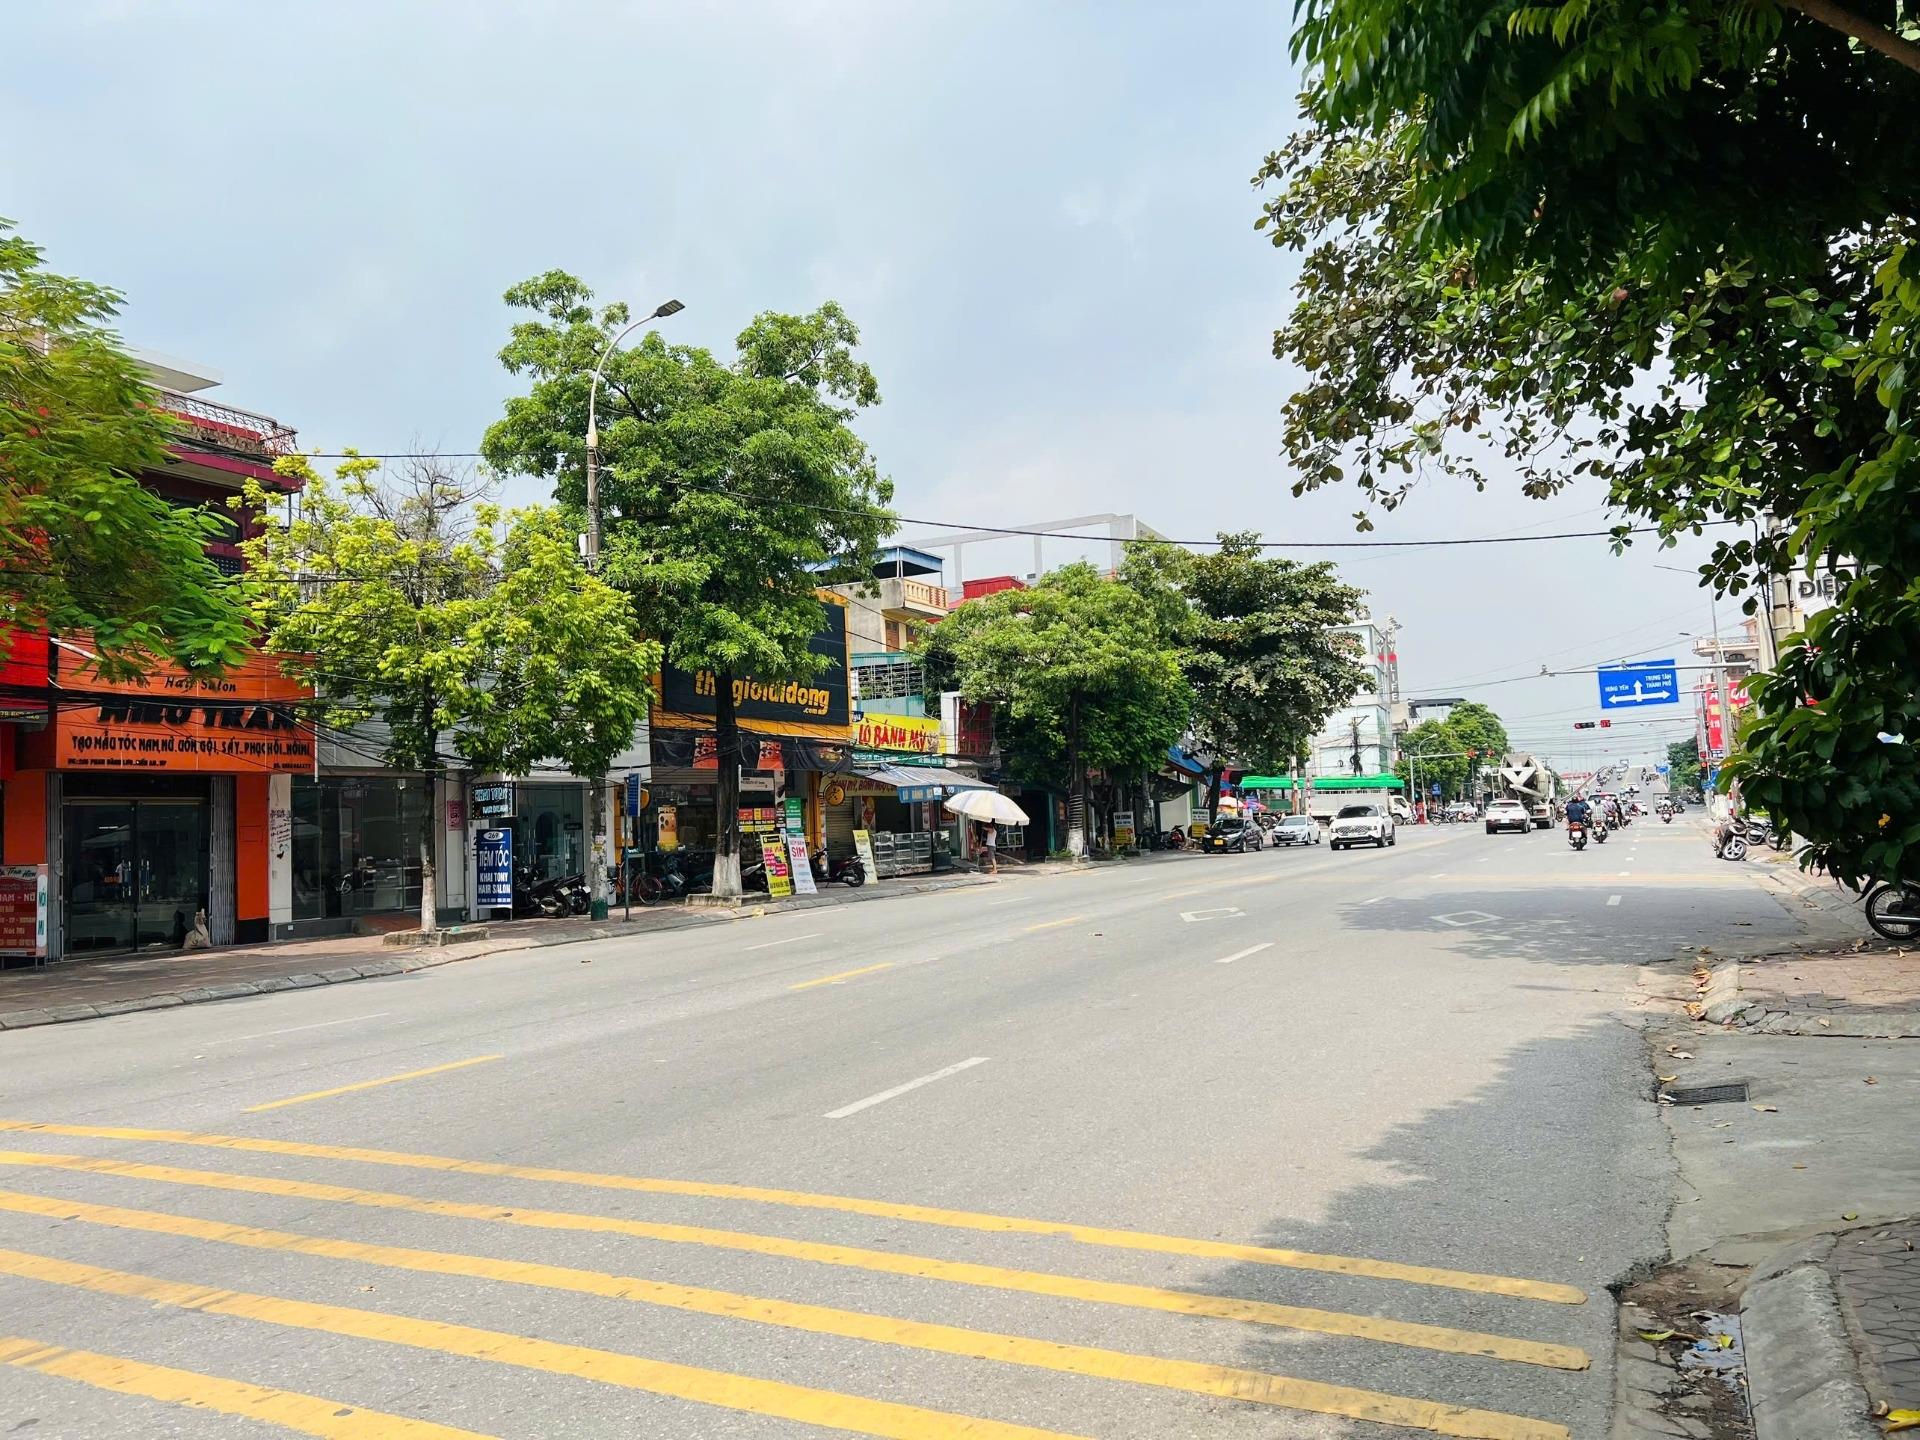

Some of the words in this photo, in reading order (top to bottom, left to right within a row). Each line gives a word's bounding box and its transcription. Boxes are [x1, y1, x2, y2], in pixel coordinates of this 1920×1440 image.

[201, 679, 236, 693] Salon
[695, 669, 830, 715] thgioididong
[72, 735, 92, 753] TẠO
[94, 728, 116, 751] MẪU
[118, 733, 137, 751] TÓC
[858, 718, 871, 746] LÒ
[874, 719, 907, 748] BÁNH
[479, 846, 494, 871] TIỆM
[495, 844, 509, 867] TÓC
[791, 846, 807, 858] SIM
[480, 872, 493, 882] KHAI
[494, 872, 508, 882] TONY
[478, 884, 492, 894] HAIR
[492, 884, 511, 894] SALON
